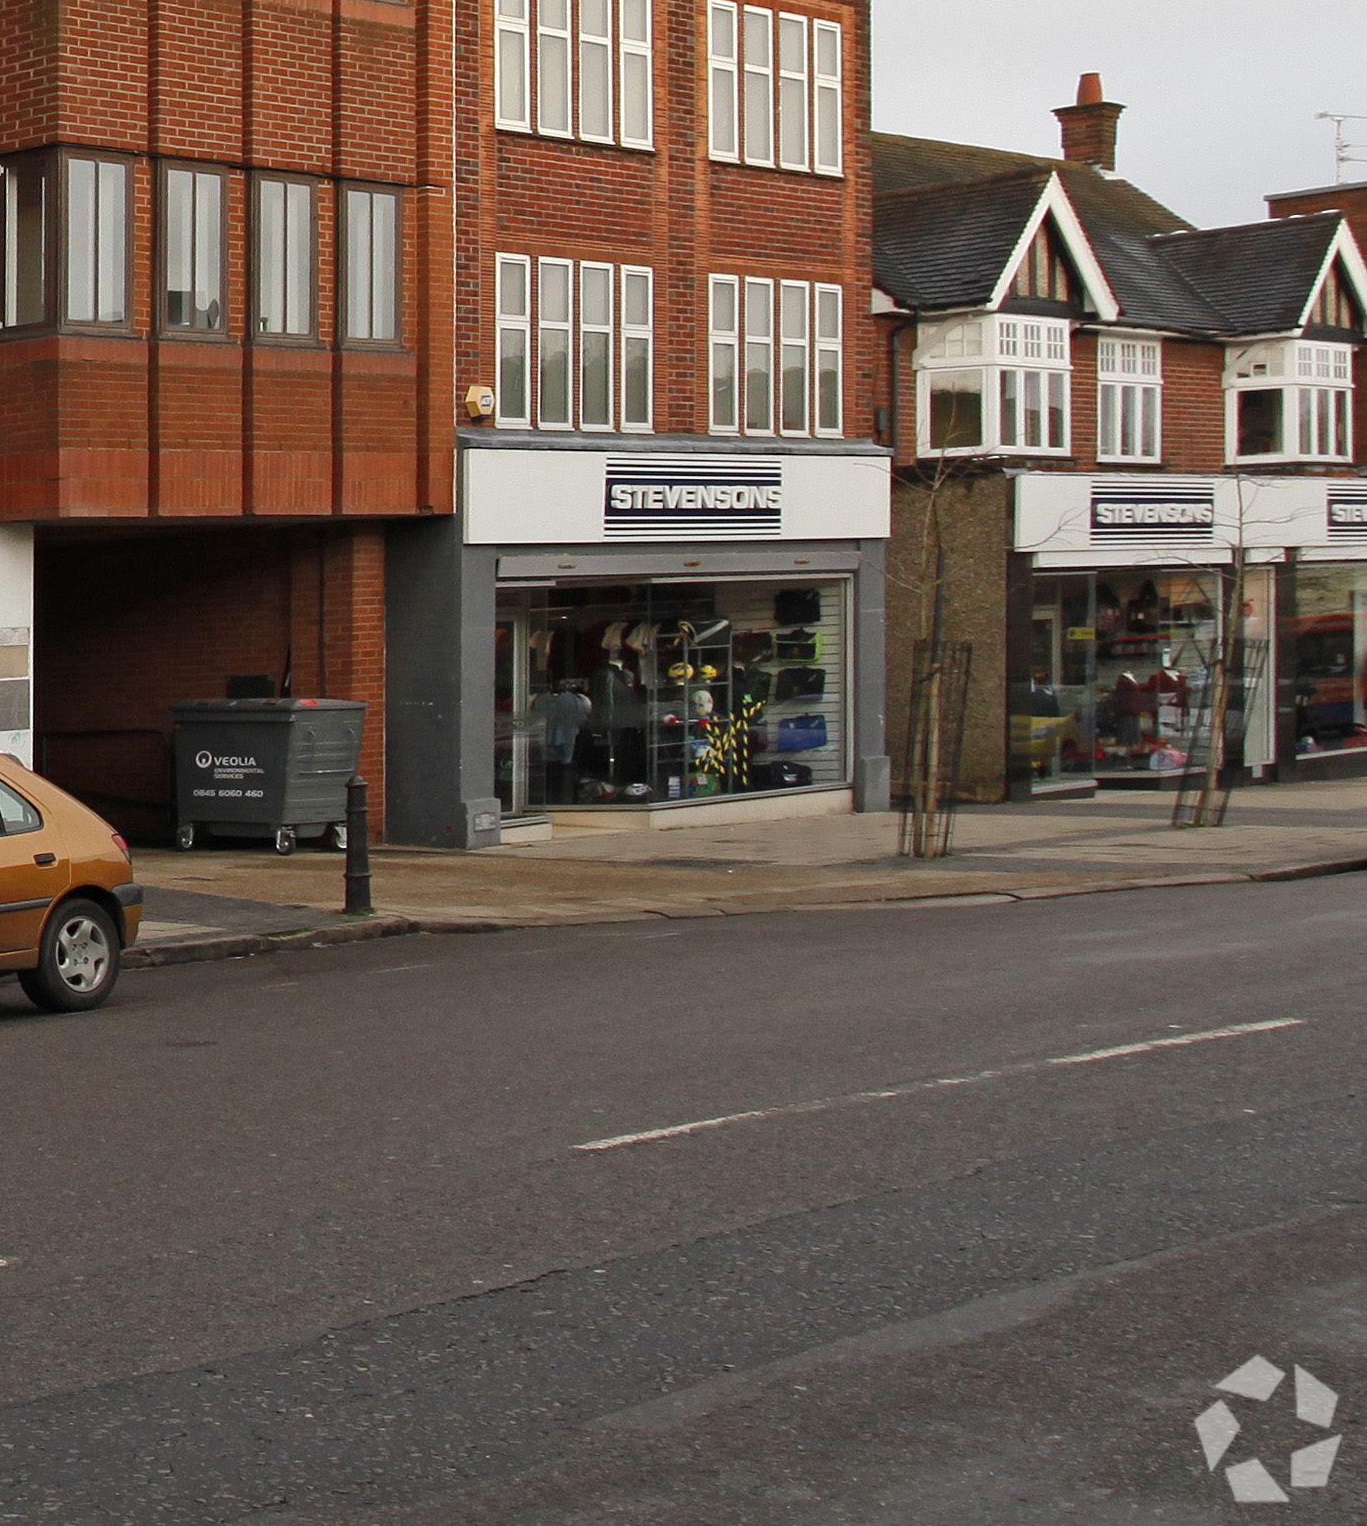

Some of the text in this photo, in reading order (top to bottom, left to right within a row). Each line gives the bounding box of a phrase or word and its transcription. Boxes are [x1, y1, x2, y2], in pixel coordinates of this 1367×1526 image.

[610, 484, 783, 510] STEVENSONS
[1096, 502, 1213, 524] STEVENSONS
[214, 757, 256, 766] VEOLIA
